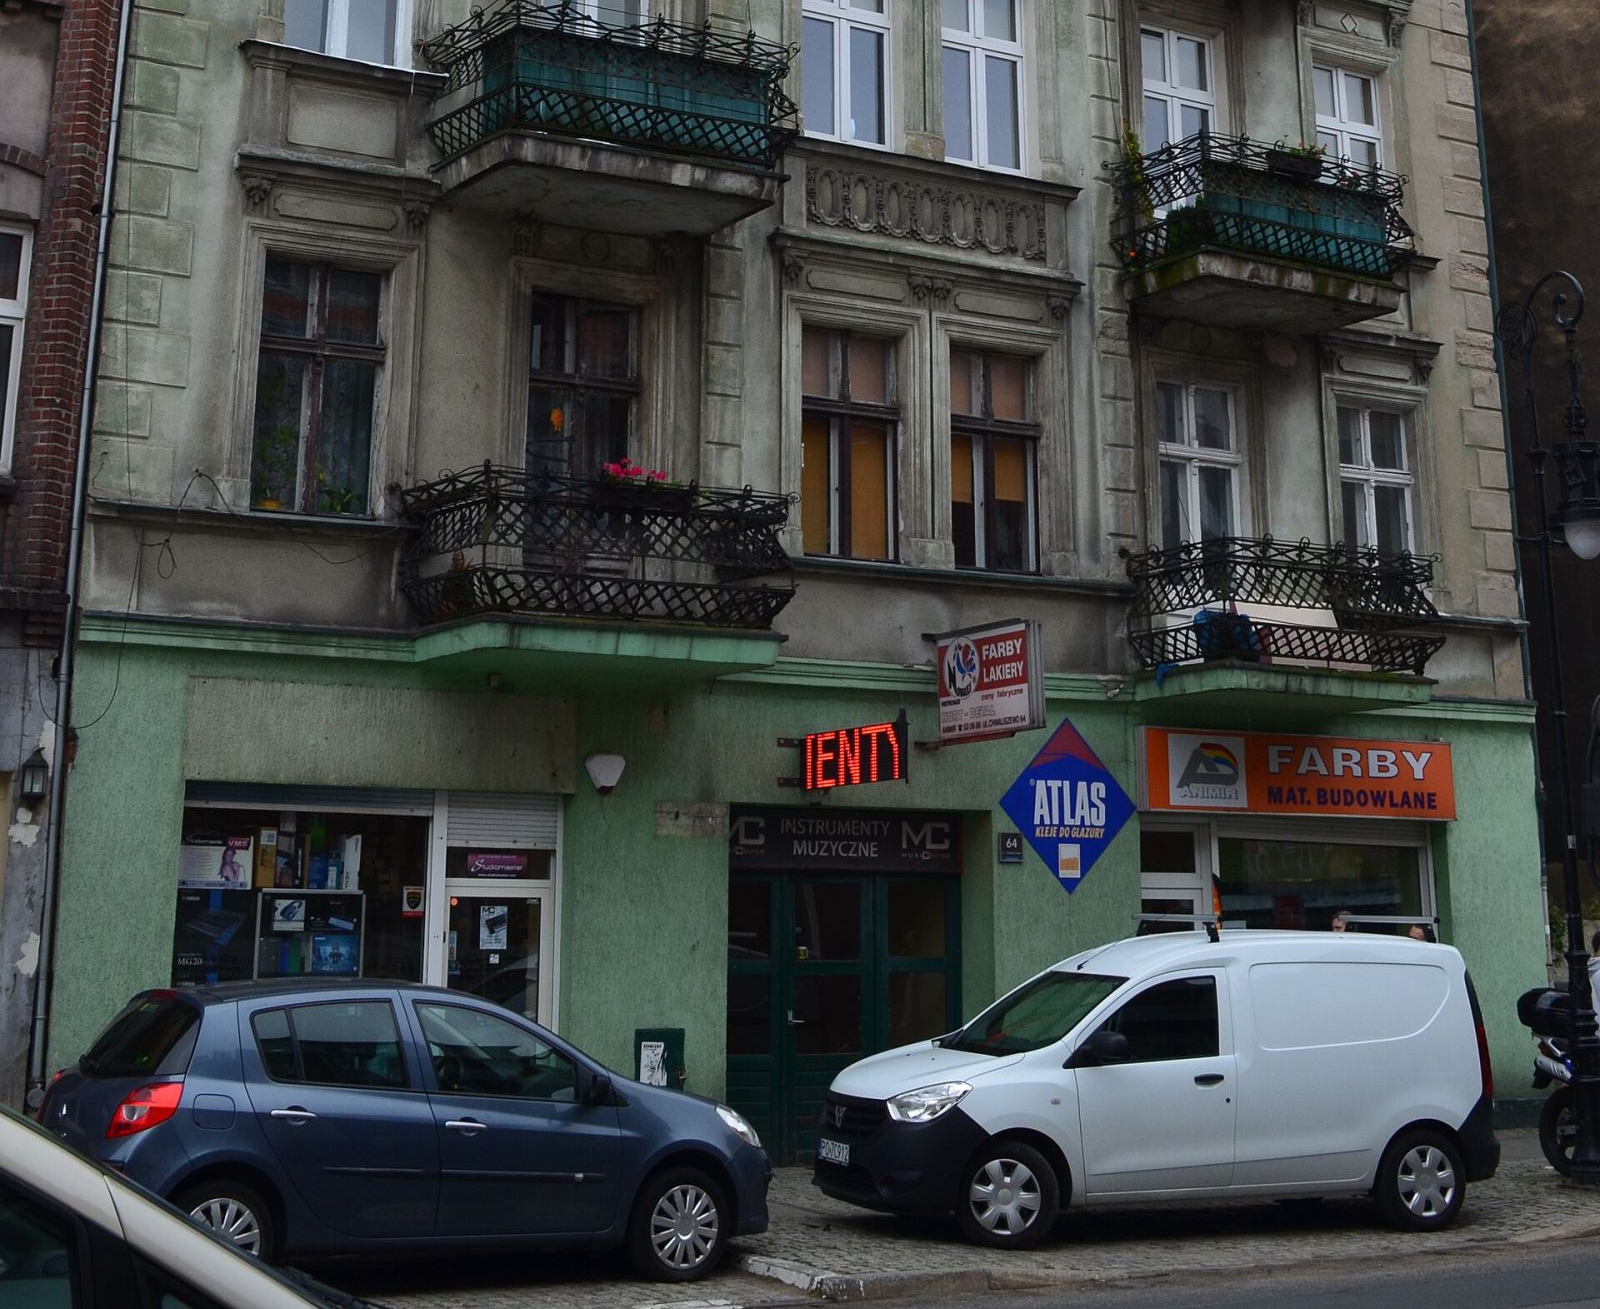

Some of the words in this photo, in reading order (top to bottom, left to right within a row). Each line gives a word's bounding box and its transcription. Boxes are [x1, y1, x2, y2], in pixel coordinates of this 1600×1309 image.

[982, 638, 1023, 660] FARBY
[983, 661, 1024, 683] LAKIERY
[981, 692, 994, 701] ceny
[997, 688, 1024, 698] fabryczne
[1267, 744, 1432, 781] FARBY
[1034, 779, 1107, 827] ATLAS
[1267, 786, 1312, 806] MAT.
[1317, 787, 1438, 811] BUDOWLANE
[780, 818, 891, 837] INSTRUMENTY
[902, 821, 950, 850] MC
[1035, 826, 1057, 838] KLEJE
[1059, 826, 1070, 838] DO
[1071, 827, 1106, 839] GLAZURY
[793, 840, 879, 857] MUZYCZNE
[1006, 837, 1018, 849] 64
[470, 859, 524, 872] Studiomaster
